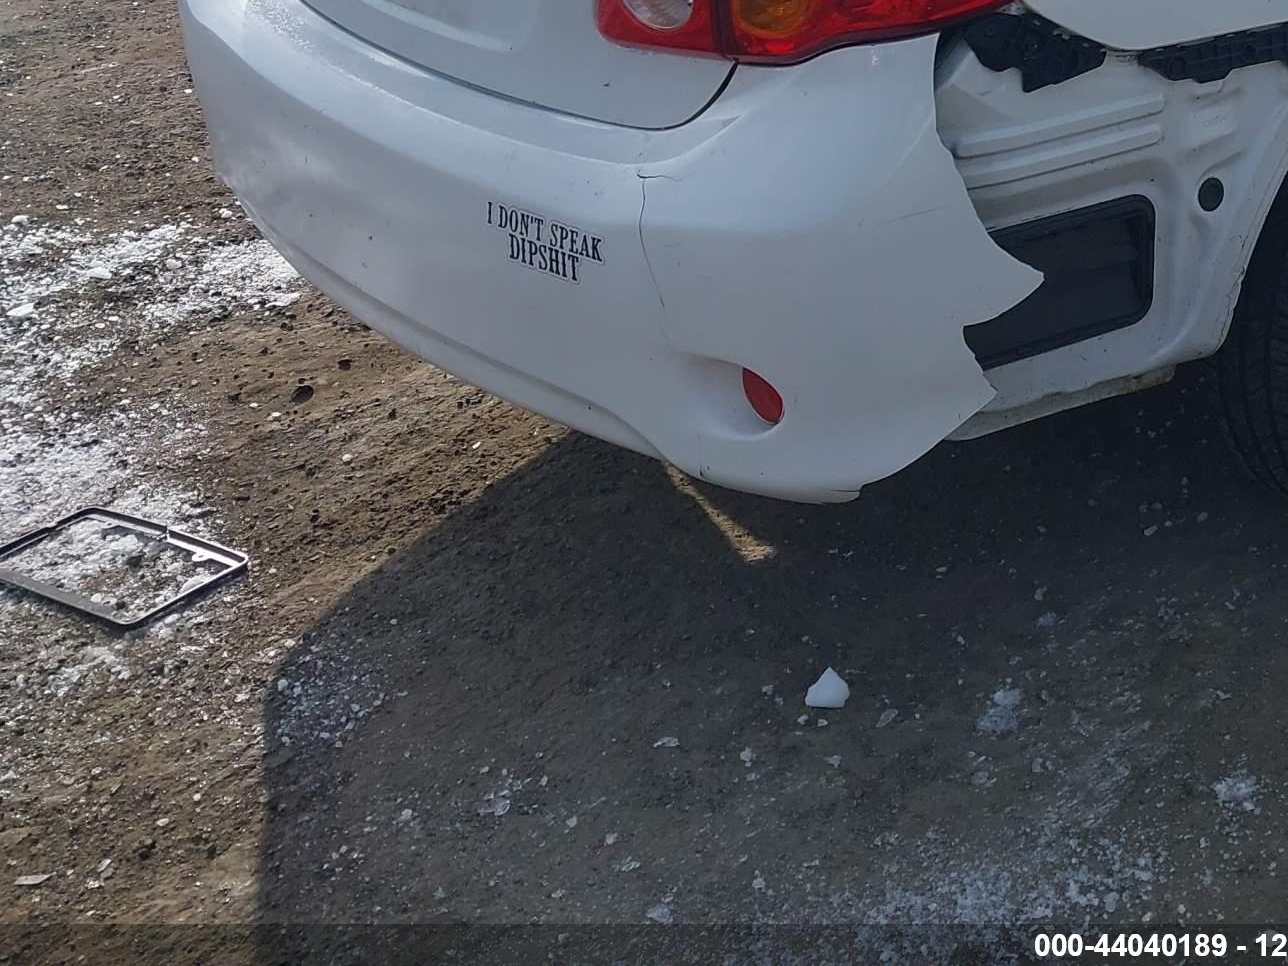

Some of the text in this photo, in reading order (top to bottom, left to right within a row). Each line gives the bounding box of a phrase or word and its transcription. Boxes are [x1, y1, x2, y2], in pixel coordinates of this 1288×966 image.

[487, 201, 603, 262] I DON'T SPEAK
[508, 233, 580, 282] DIPSHIT
